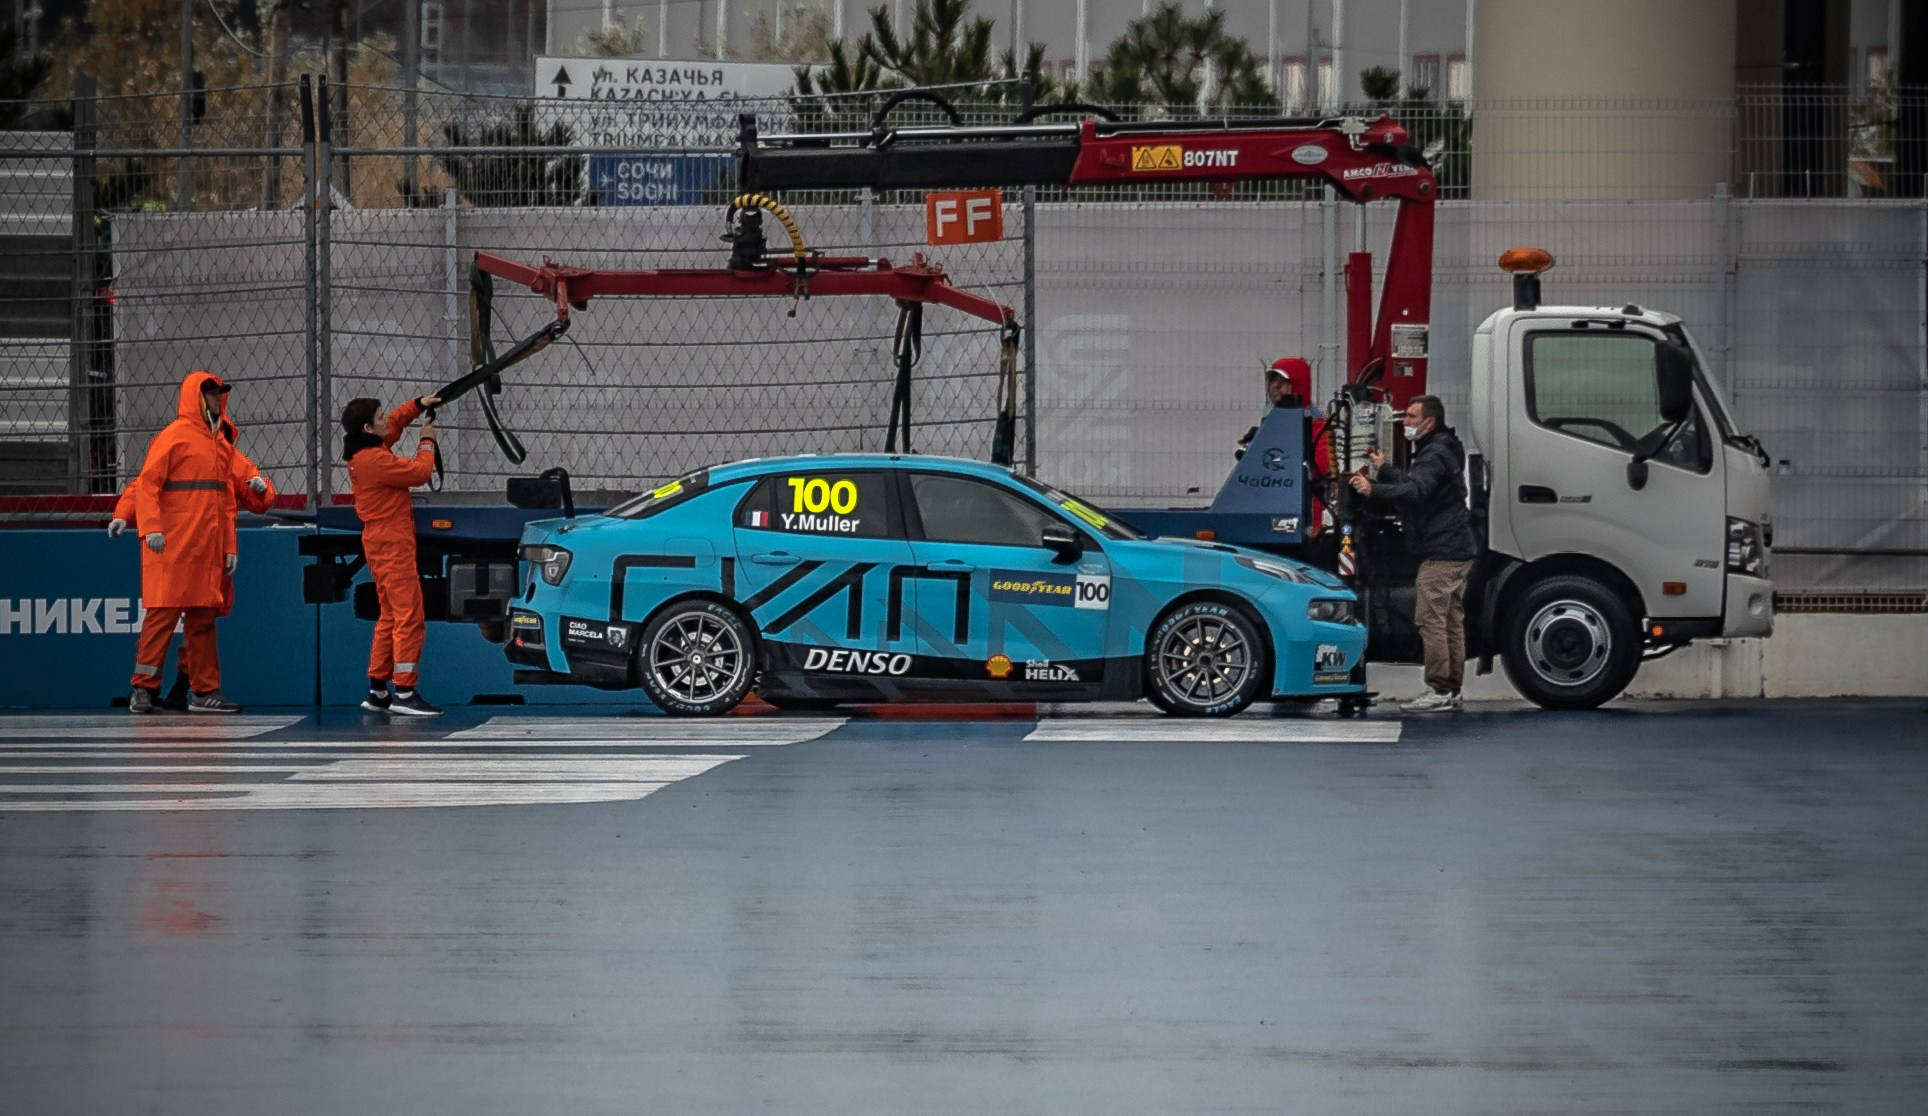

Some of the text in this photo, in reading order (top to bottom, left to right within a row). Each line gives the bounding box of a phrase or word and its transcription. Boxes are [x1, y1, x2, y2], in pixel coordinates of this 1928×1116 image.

[626, 67, 723, 86] КАЗАЧЬЯ
[1184, 150, 1238, 168] 807NT
[617, 161, 673, 180] СОЧИ
[1343, 167, 1373, 179] AMCO
[617, 182, 677, 201] SOCHI
[935, 198, 992, 237] FF
[788, 478, 857, 514] 100
[781, 513, 860, 532] Y.Muller
[992, 580, 1072, 595] GOODYEAR
[1076, 582, 1109, 602] 100
[568, 621, 588, 630] CIAO
[568, 629, 603, 640] MARCELA
[803, 648, 913, 675] DENSO
[1025, 658, 1050, 668] Shell
[1024, 664, 1080, 681] HELIX
